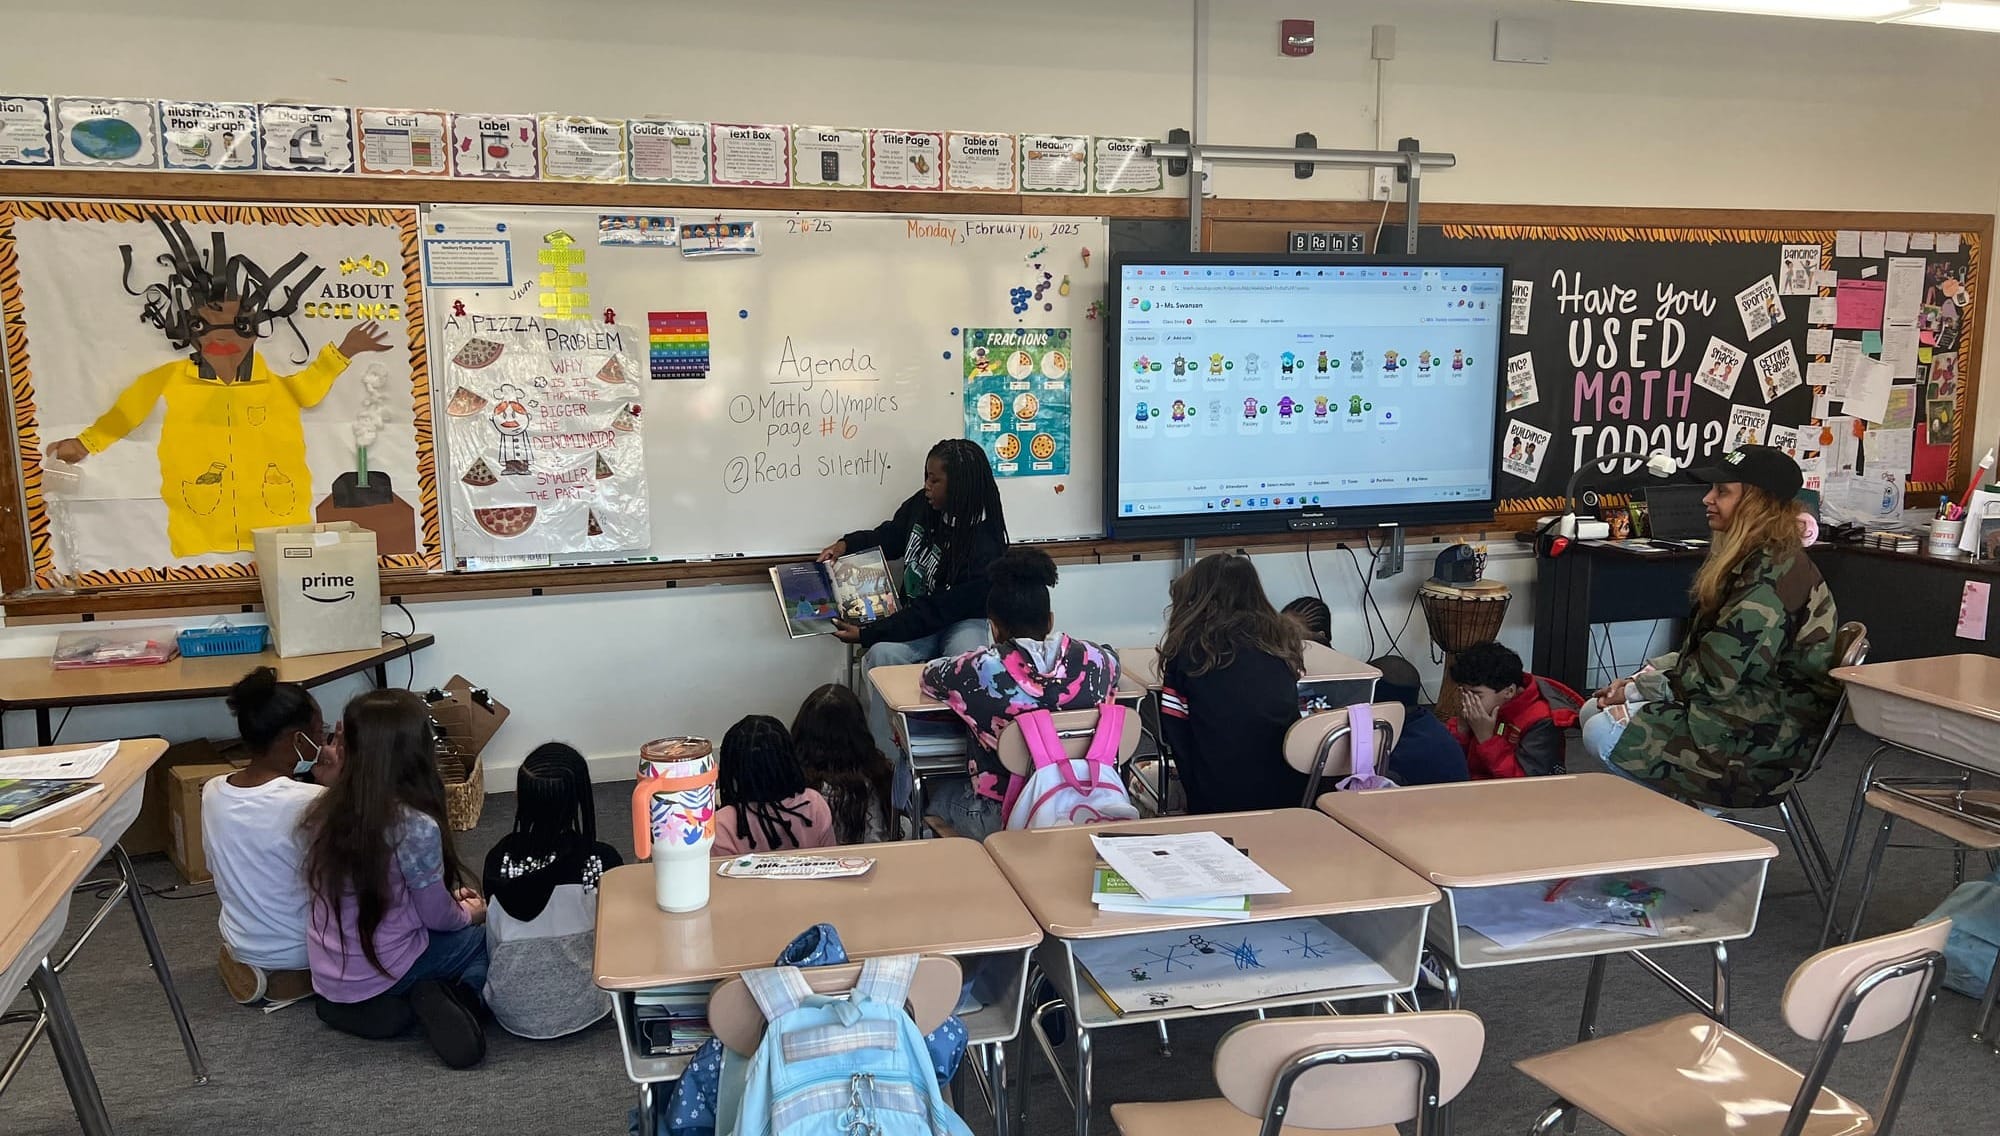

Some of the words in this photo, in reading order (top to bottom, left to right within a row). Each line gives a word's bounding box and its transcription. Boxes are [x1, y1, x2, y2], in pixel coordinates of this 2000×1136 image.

[90, 104, 120, 116] Map
[237, 109, 246, 120] &
[278, 111, 332, 124] Diagram
[385, 116, 418, 127] Chart
[479, 120, 510, 131] Label
[555, 123, 608, 136] Hyperlink
[633, 124, 664, 136] Guide
[667, 126, 701, 137] Words
[729, 130, 750, 140] Text
[752, 131, 771, 140] Box
[818, 132, 840, 143] Icon
[883, 135, 904, 145] Title
[908, 135, 931, 147] Page
[963, 136, 986, 147] Table
[989, 137, 999, 147] of
[962, 146, 999, 156] Contents
[1036, 140, 1073, 151] Heading
[966, 221, 1026, 240] February
[1050, 223, 1081, 236] 2025
[339, 254, 390, 278] MAD
[320, 283, 394, 299] ABOUT
[1551, 268, 1638, 316] Have
[1655, 281, 1717, 321] you
[304, 302, 400, 321] SCIENCE
[444, 315, 459, 330] A
[472, 315, 541, 333] PIZZA
[545, 327, 623, 352] PROBLEM
[1568, 317, 1686, 369] USED
[550, 359, 584, 375] WHY
[778, 335, 877, 391] Agenda
[551, 378, 565, 388] IS
[573, 377, 589, 387] IT
[542, 391, 577, 401] THAT
[580, 390, 600, 401] THE
[540, 403, 589, 418] BIGGER
[758, 390, 810, 422] Math
[820, 388, 899, 428] Olympics
[535, 421, 559, 431] THE
[767, 420, 812, 447] page
[532, 430, 616, 449] DENOMINATOR
[754, 451, 801, 484] Read
[818, 449, 892, 486] Silently.
[536, 467, 591, 486] SMALLER
[526, 491, 549, 501] THE
[555, 486, 585, 501] PART
[301, 572, 355, 591] prime
